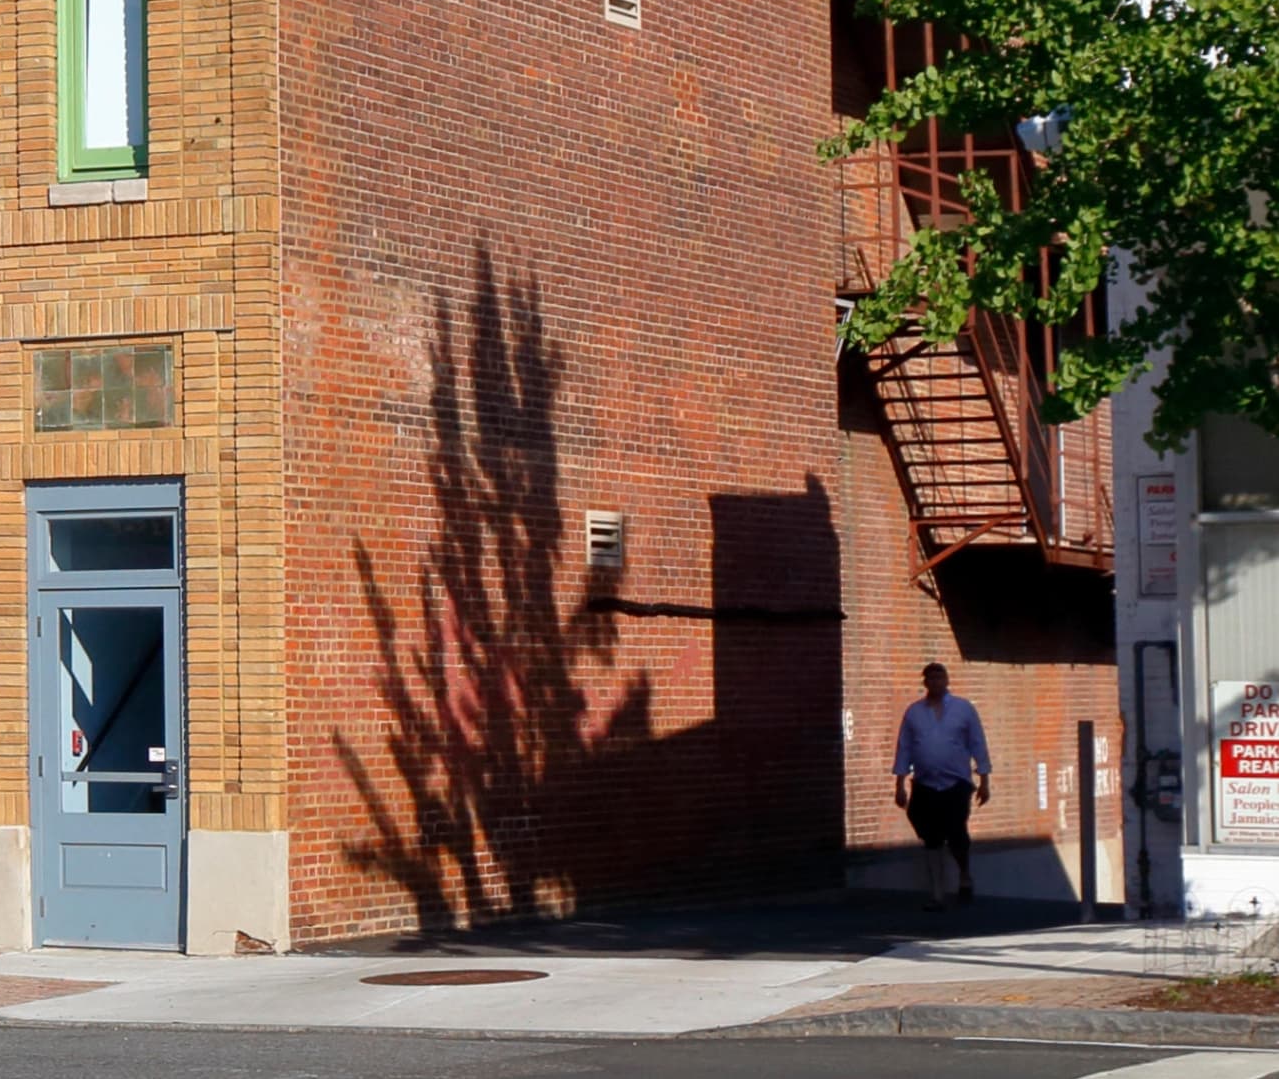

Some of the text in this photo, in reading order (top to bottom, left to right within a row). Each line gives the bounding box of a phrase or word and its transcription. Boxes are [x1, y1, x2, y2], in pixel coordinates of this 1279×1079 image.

[1245, 684, 1273, 700] DO
[1225, 781, 1271, 795] Salon
[1229, 812, 1279, 825] Jamaic
